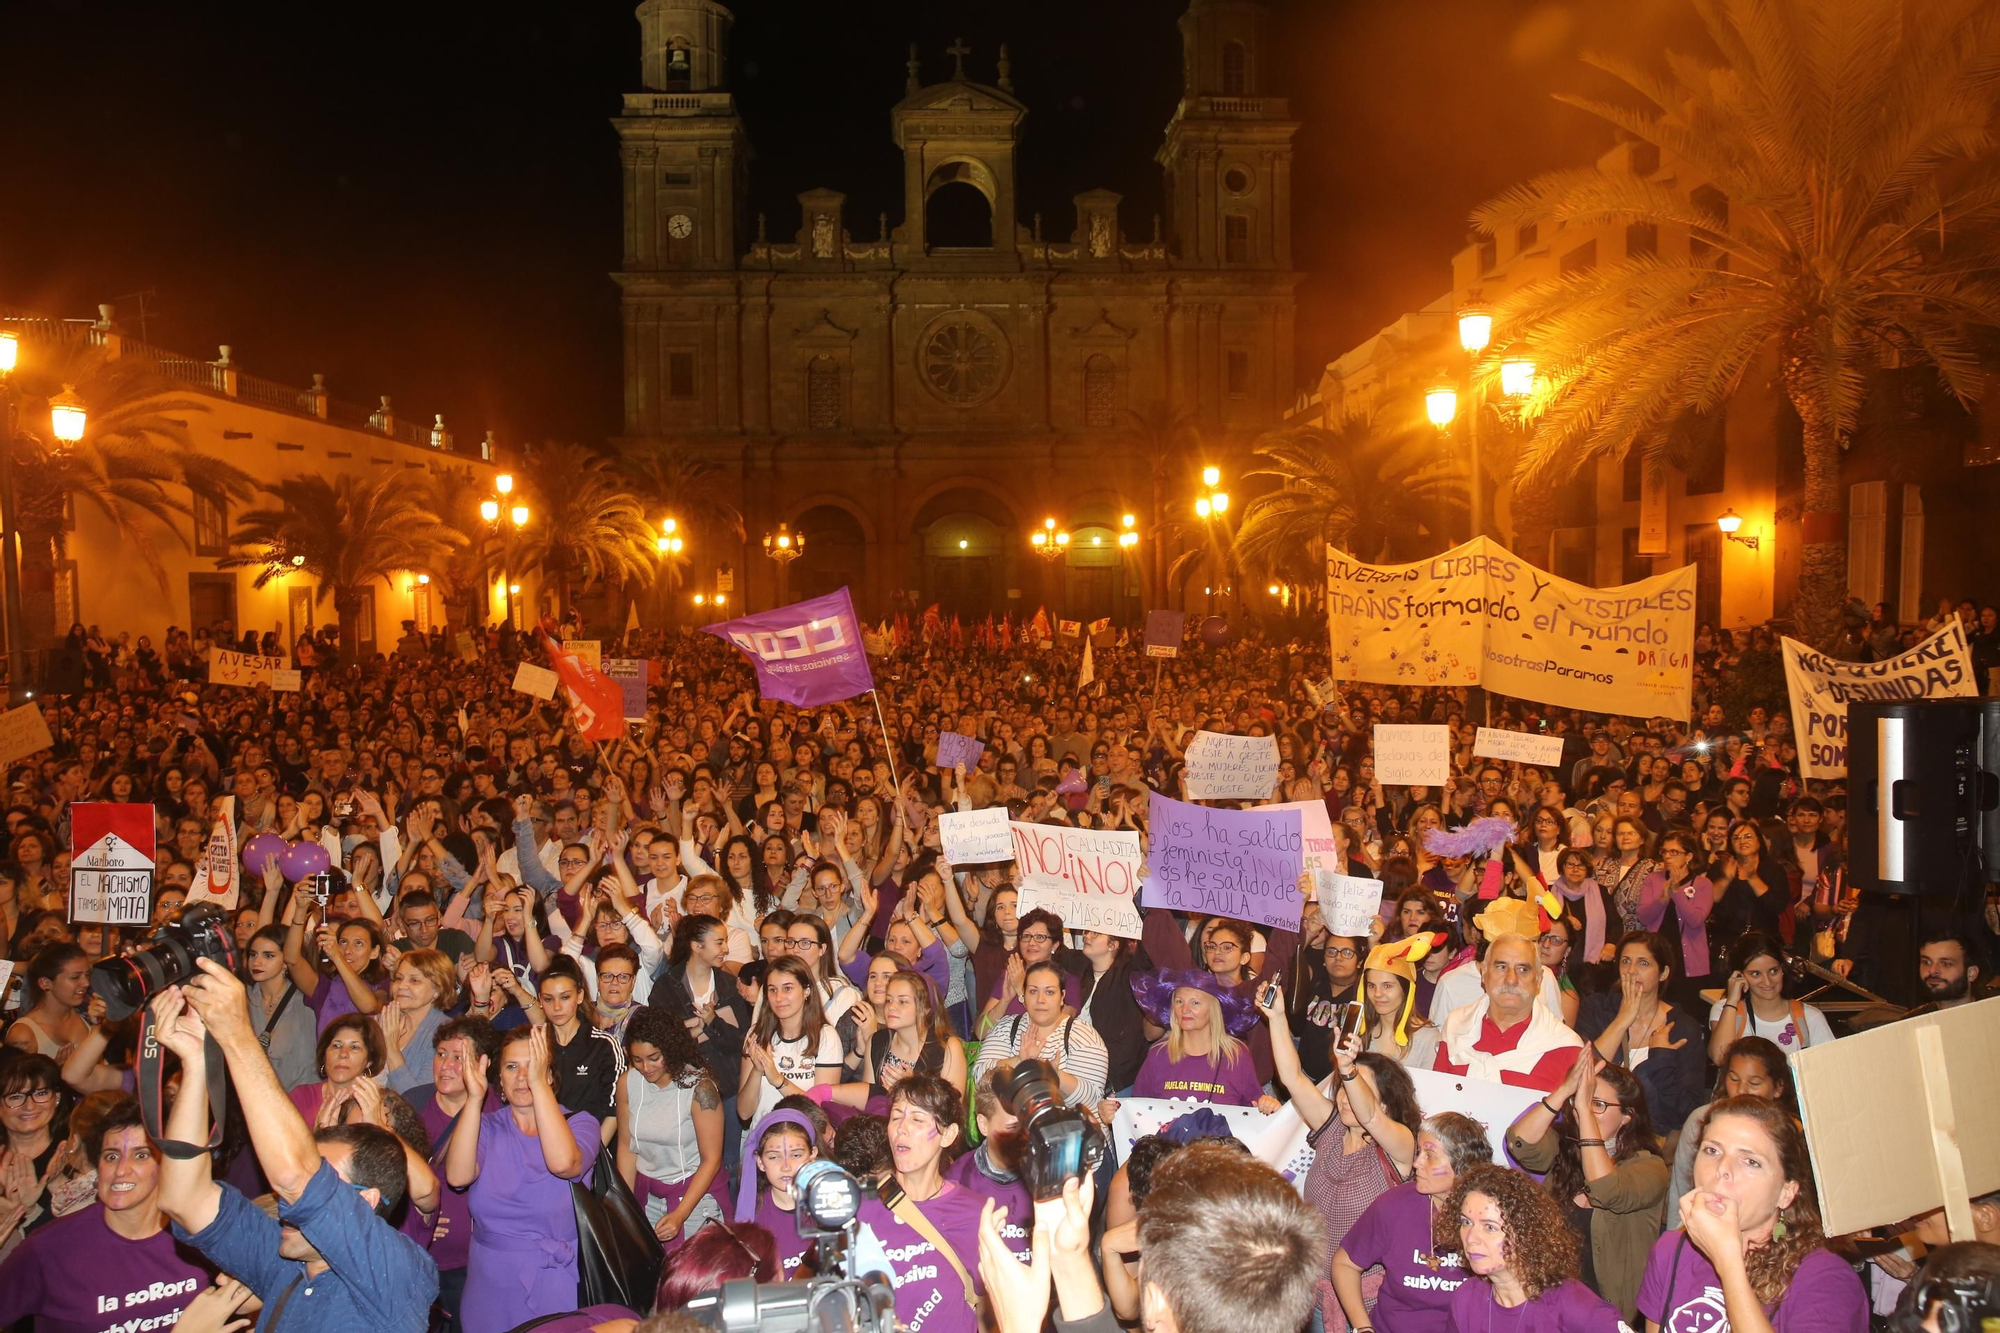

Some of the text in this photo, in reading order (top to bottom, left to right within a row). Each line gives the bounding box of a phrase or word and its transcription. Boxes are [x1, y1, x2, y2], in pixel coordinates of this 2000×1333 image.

[1430, 555, 1521, 582] LIBRES
[1530, 572, 1551, 602] Y
[1562, 589, 1693, 619] VISIBLES
[1533, 608, 1559, 634] el
[1569, 618, 1669, 646] mundo
[1799, 652, 1836, 677] NOS
[1827, 659, 1963, 703] DESUNIDAS
[1206, 736, 1236, 749] NORTE
[1242, 740, 1250, 750] A
[1257, 741, 1276, 751] SUR
[1375, 728, 1413, 744] Somos
[1488, 731, 1511, 739] ABUELA
[1187, 746, 1272, 764] DE ESTE A OESTE
[1376, 748, 1447, 763] Esclavas del
[1186, 760, 1203, 769] LAS
[1208, 762, 1250, 772] MUJERES
[1384, 766, 1442, 782] Siglo XXI
[1222, 773, 1236, 783] LO
[1243, 773, 1266, 783] QUE
[1204, 783, 1245, 795] CUESTE
[1957, 783, 1965, 795] 5
[1157, 806, 1301, 852] Nos ha salido
[946, 833, 958, 845] NO
[87, 854, 124, 867] Marlboro
[1012, 827, 1140, 879] ¡NO! CALLADITA
[80, 873, 150, 893] EL MACHISMO
[1159, 862, 1297, 903] os he salido de
[1342, 881, 1365, 898] feliz
[1166, 882, 1190, 906] la
[1433, 890, 1451, 898] HUELGA
[107, 896, 145, 920] MATA
[1345, 902, 1359, 910] me
[1070, 901, 1101, 926] MÁS
[1104, 908, 1141, 933] GUAPA
[1264, 914, 1299, 932] @srtabebi
[1164, 1081, 1225, 1094] HUELGA FEMINISTA
[97, 1278, 198, 1314] la soRora
